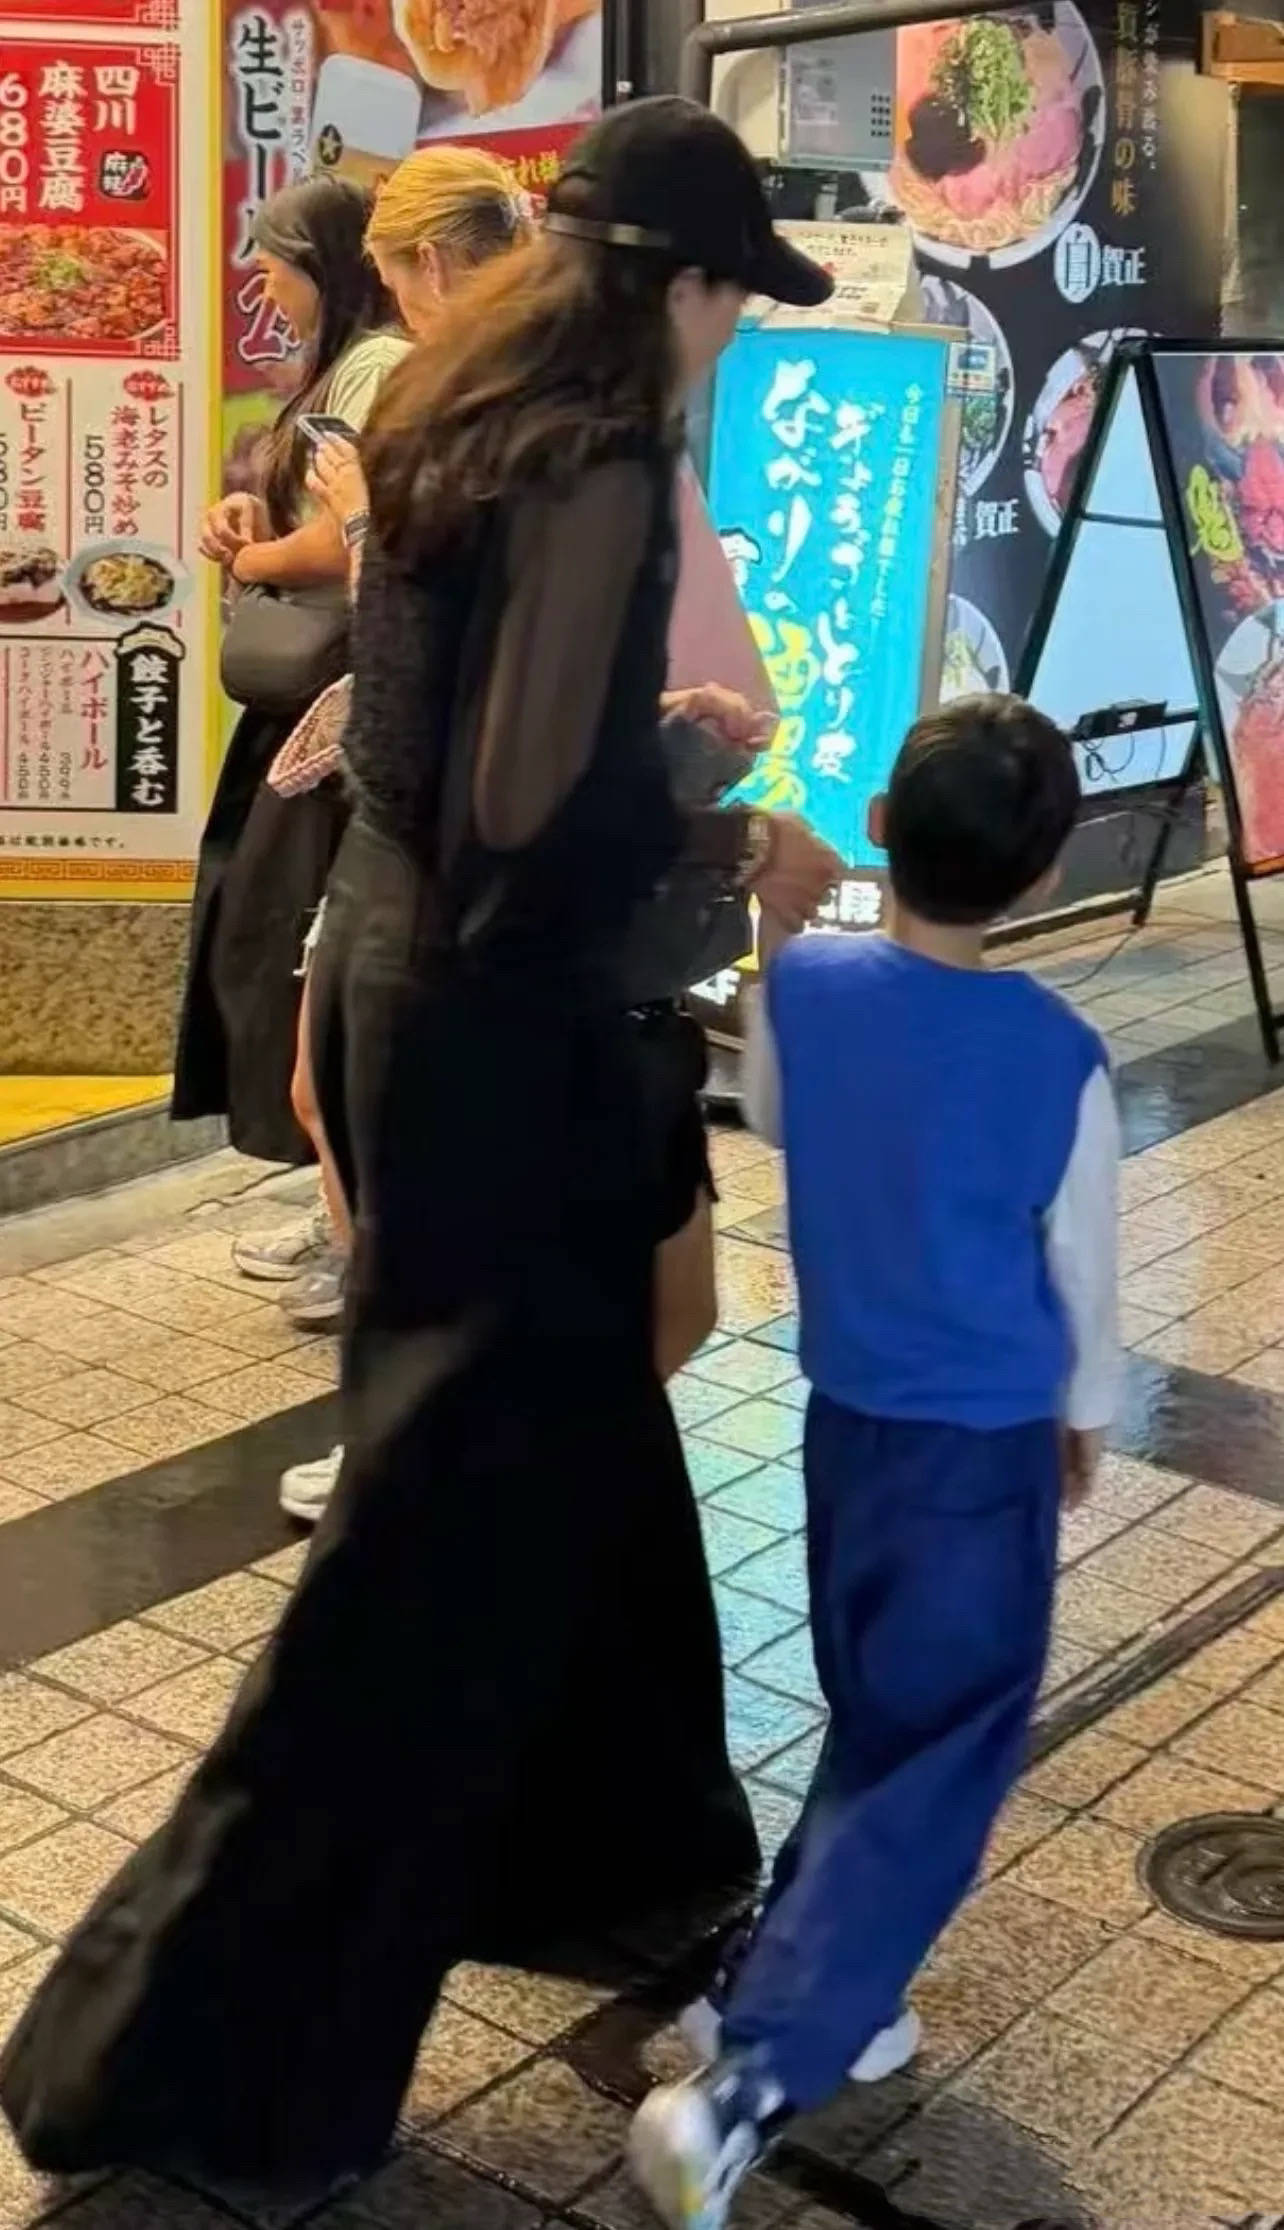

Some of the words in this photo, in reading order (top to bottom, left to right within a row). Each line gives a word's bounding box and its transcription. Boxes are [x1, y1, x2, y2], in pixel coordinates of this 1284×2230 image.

[38, 60, 88, 212] 麻婆豆腐
[94, 66, 139, 135] 四川
[84, 435, 105, 535] 580円
[111, 404, 141, 536] 海老みそ炒め
[143, 406, 169, 488] レタスの
[80, 649, 110, 770] ハイボール
[129, 654, 169, 806] 餃子と呑む
